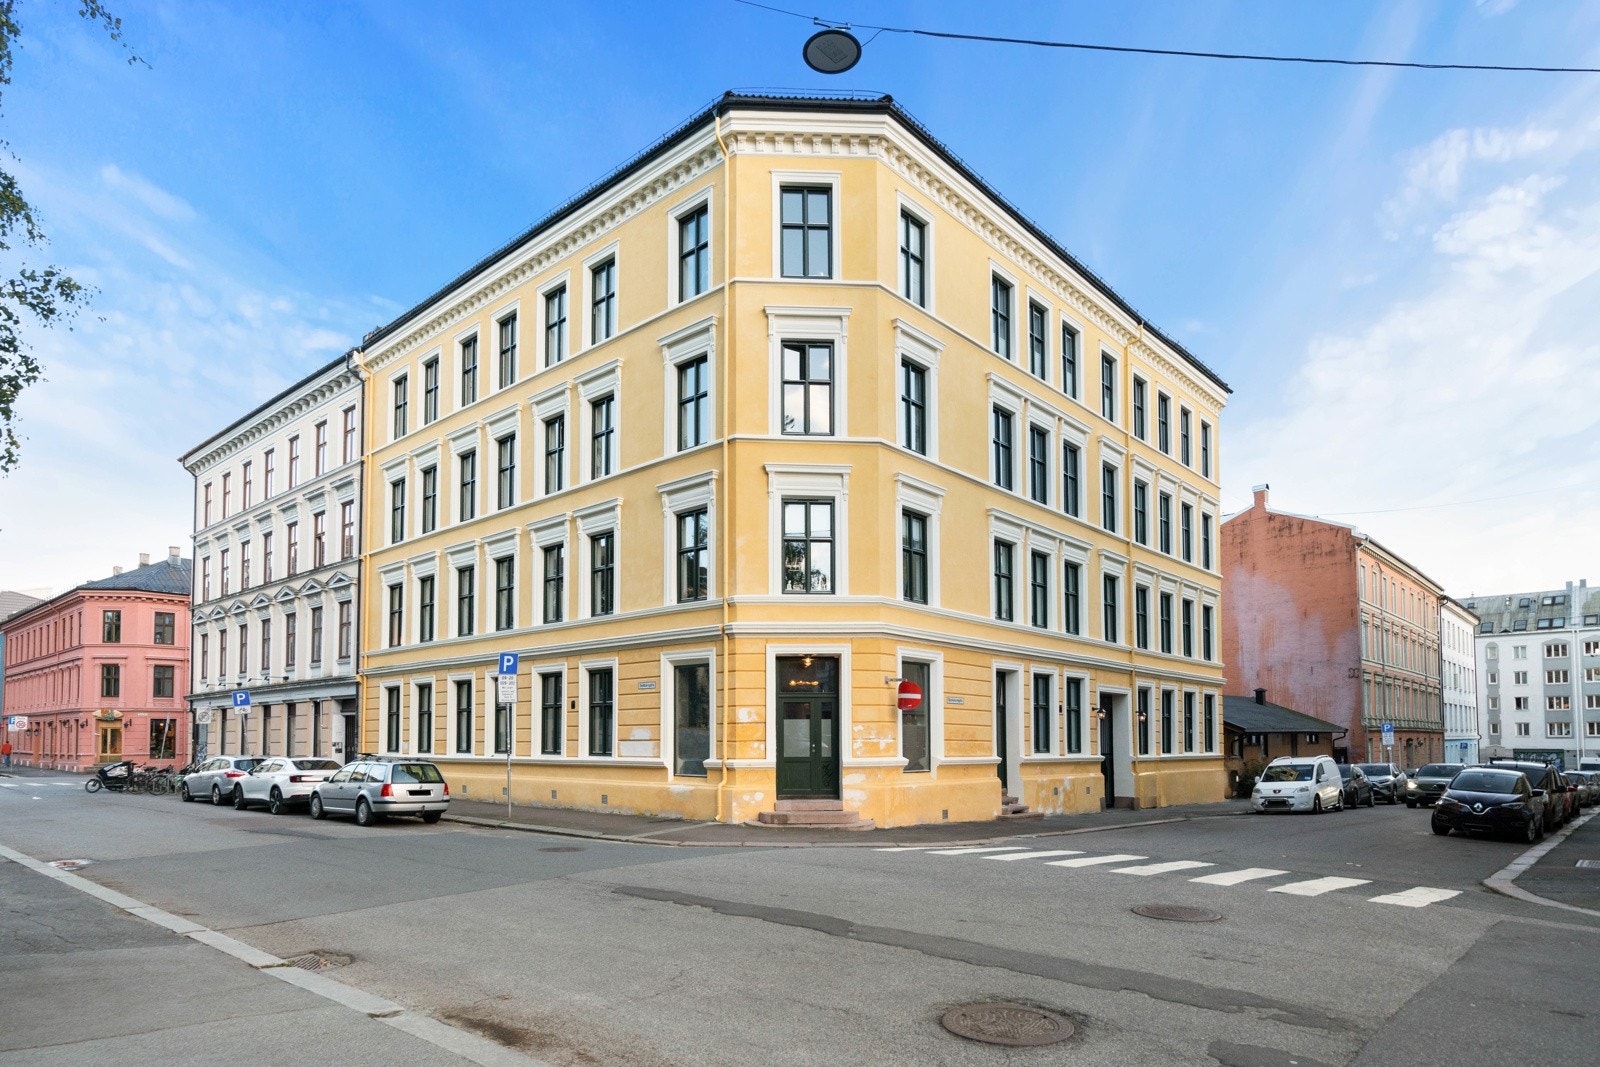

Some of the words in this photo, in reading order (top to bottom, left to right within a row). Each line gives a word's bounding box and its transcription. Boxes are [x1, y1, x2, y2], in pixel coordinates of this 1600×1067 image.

[503, 655, 514, 672] P
[237, 694, 246, 704] P
[1384, 724, 1391, 732] P
